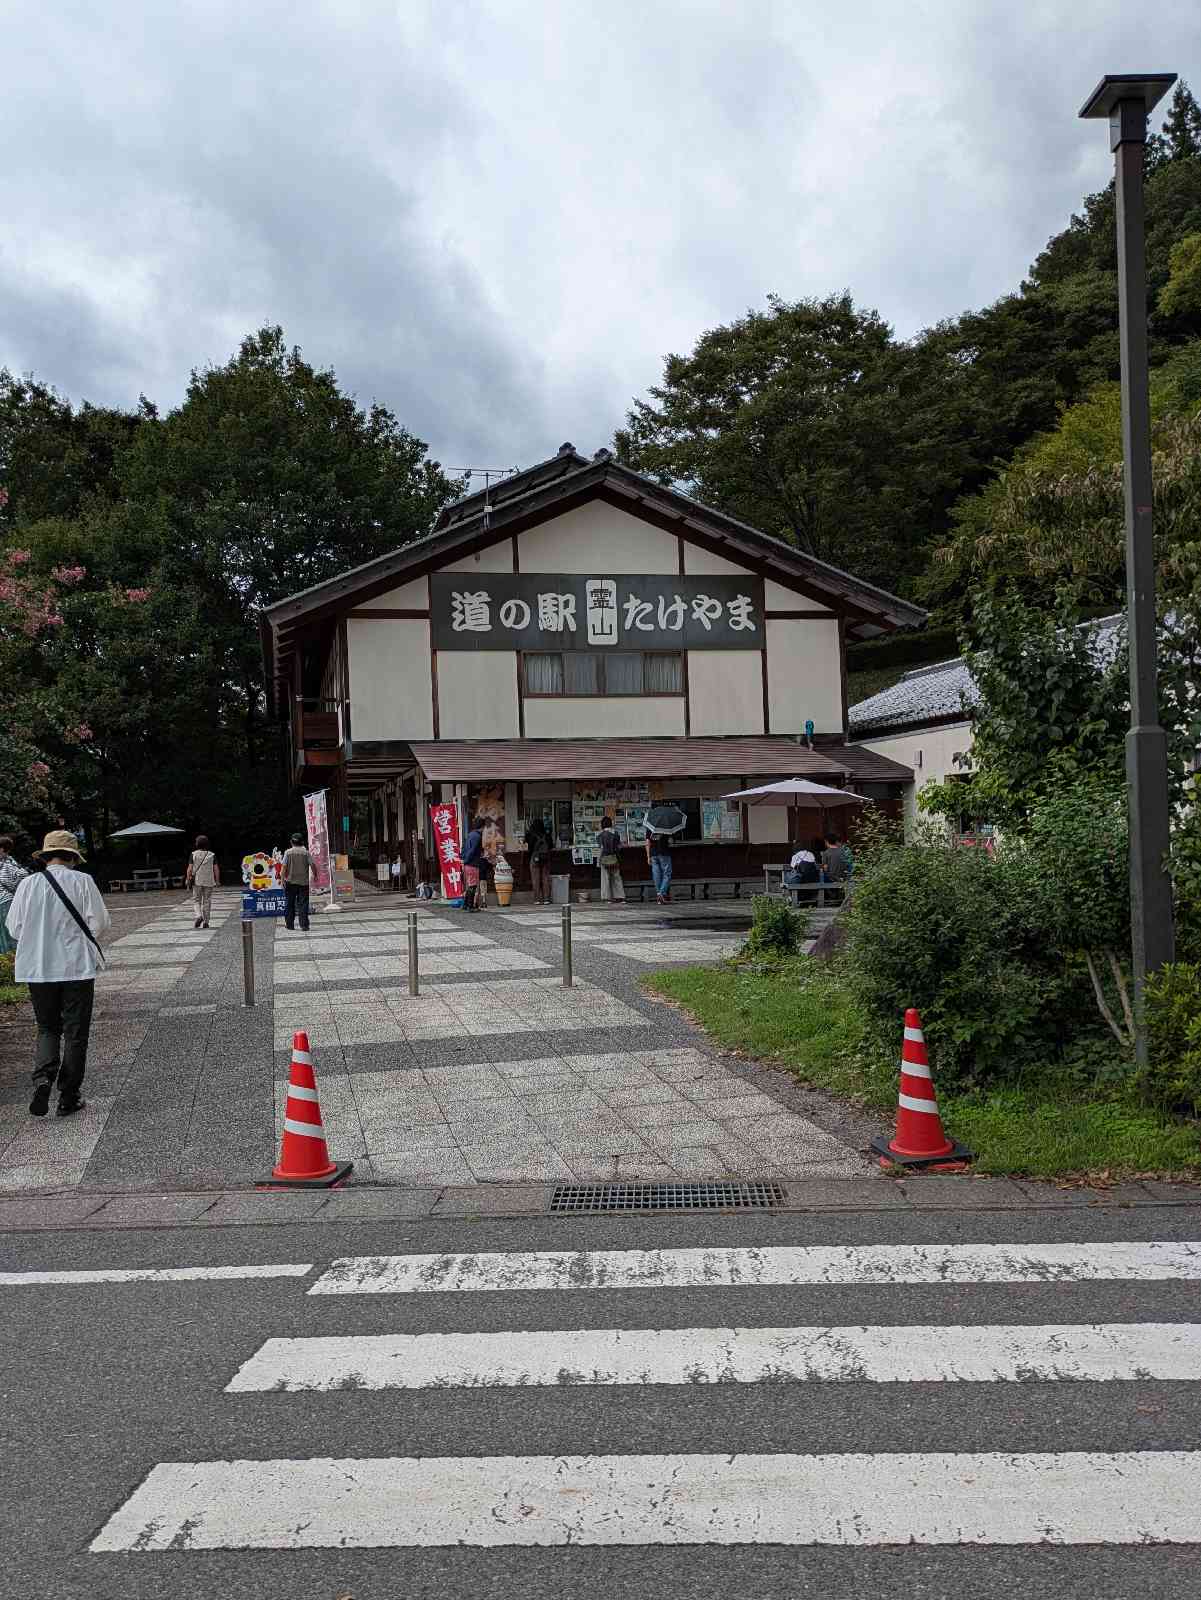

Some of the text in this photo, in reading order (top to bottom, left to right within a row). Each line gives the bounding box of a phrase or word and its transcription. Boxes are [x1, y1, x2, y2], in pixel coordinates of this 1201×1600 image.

[451, 584, 757, 636] 道の駅 霊山 たけやま
[433, 809, 461, 892] 営業中
